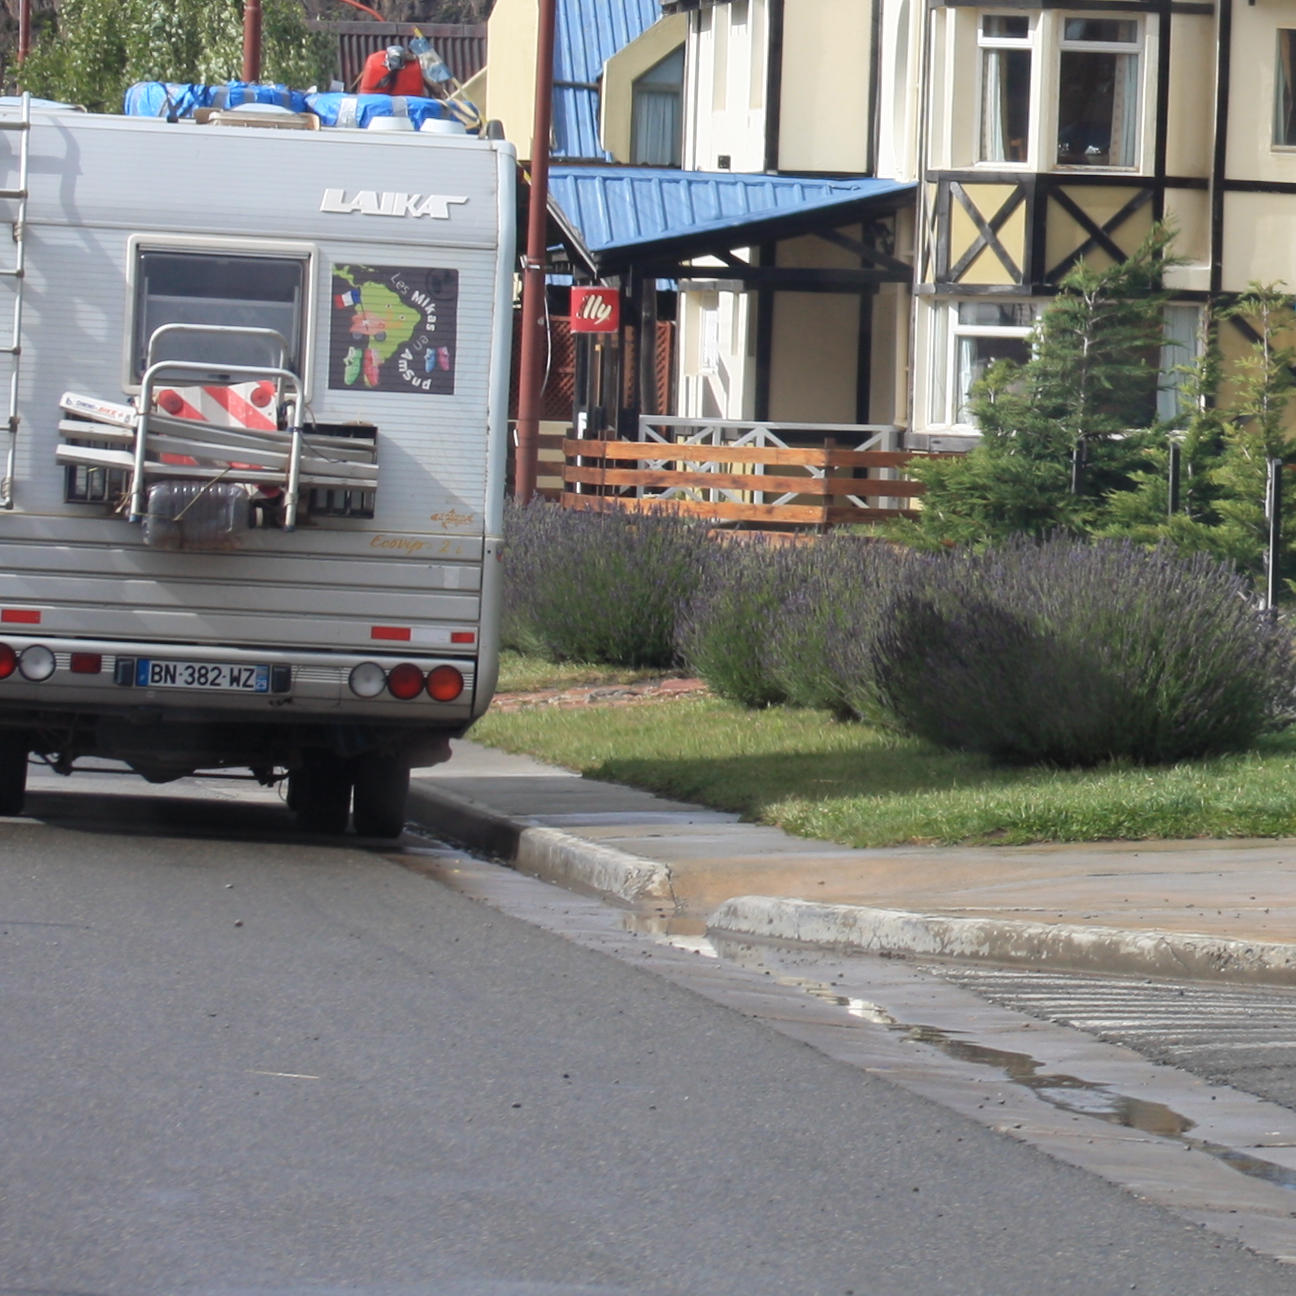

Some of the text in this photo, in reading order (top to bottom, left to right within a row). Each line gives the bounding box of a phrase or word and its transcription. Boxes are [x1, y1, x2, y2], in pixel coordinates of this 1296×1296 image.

[320, 188, 469, 220] LAIKA
[390, 272, 411, 295] Les
[413, 335, 429, 351] en
